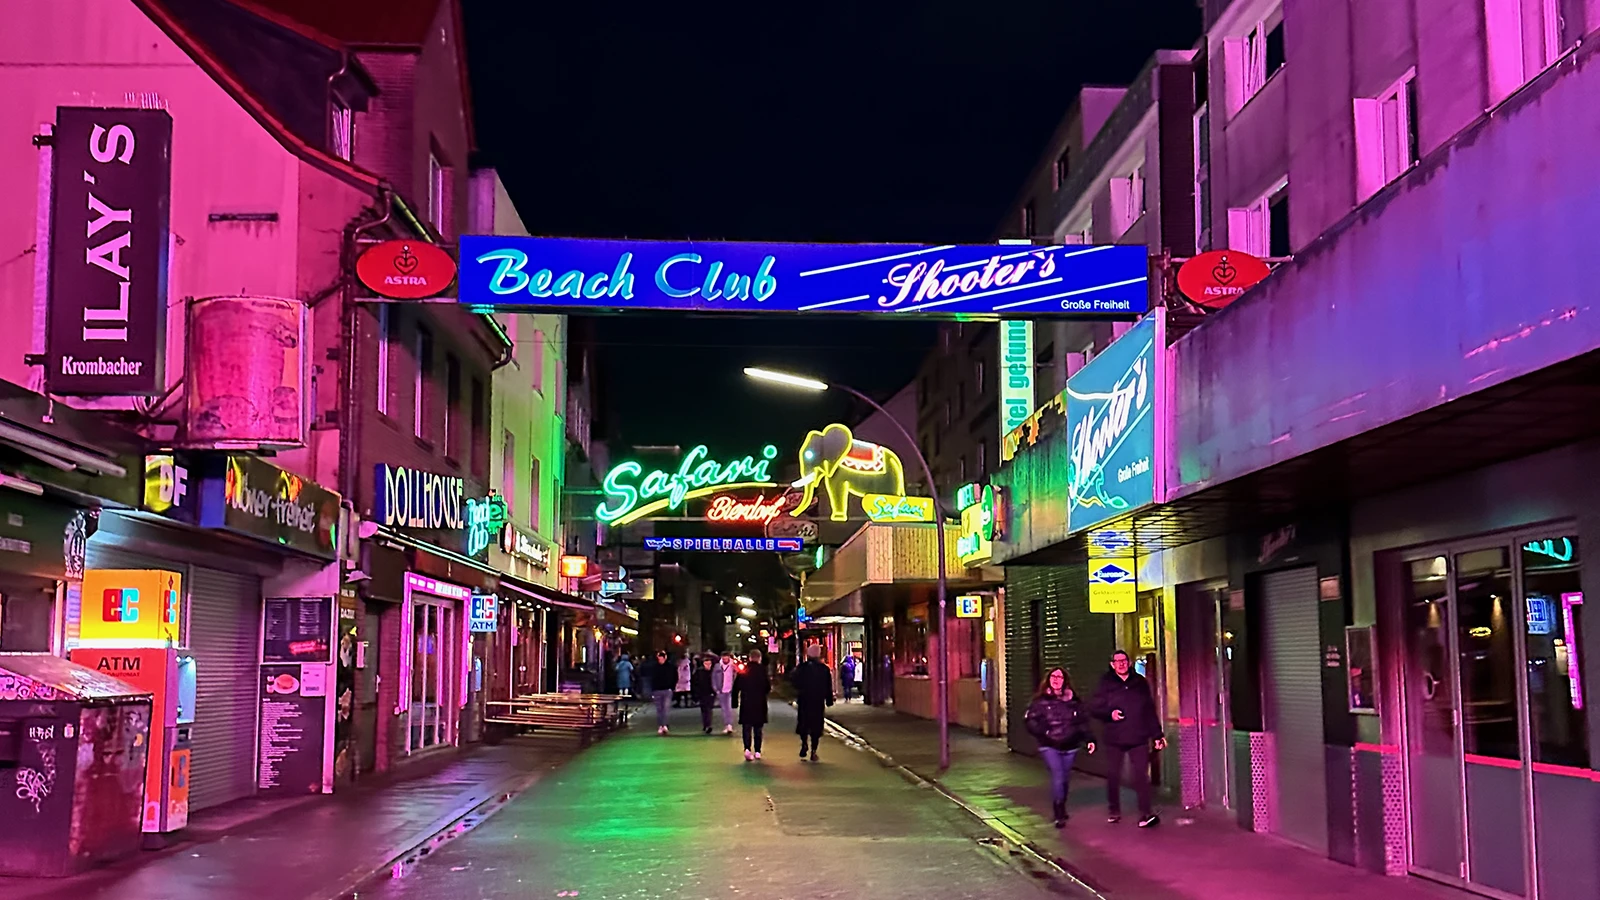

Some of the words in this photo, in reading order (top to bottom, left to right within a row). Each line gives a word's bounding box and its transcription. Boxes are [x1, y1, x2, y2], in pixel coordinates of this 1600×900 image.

[384, 276, 427, 285] ASTRA
[476, 248, 634, 300] Beach
[655, 253, 776, 301] Club
[878, 249, 1056, 307] Shooter's
[1204, 286, 1244, 295] ASTRA
[1061, 300, 1091, 310] Große
[1094, 300, 1130, 310] Freiheit
[62, 356, 142, 375] Krombacher
[159, 463, 187, 506] DF
[596, 444, 778, 522] Safari
[385, 463, 464, 530] DOLLHOUSE
[708, 495, 786, 525] Bierdorf
[672, 538, 775, 550] SPIELHALLE
[471, 622, 494, 630] ATM
[97, 657, 141, 670] ATM
